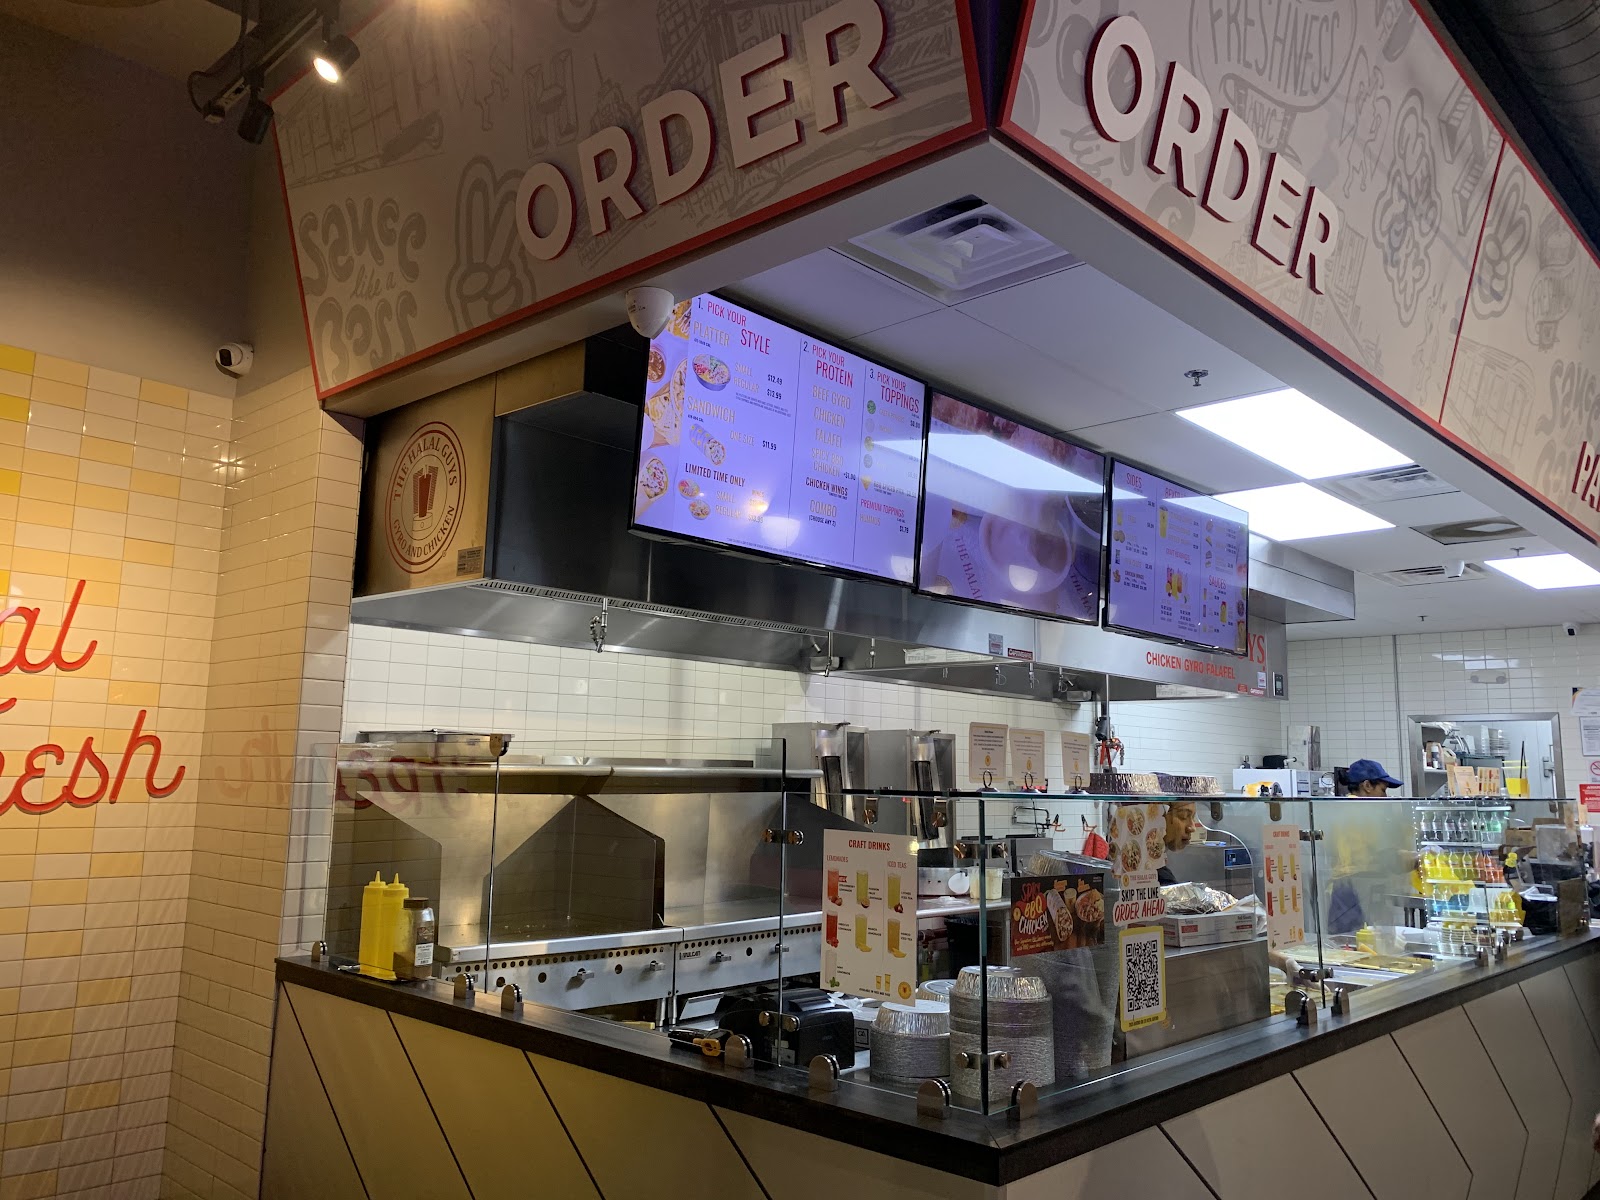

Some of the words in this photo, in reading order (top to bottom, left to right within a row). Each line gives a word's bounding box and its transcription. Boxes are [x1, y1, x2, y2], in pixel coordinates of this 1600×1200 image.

[1209, 0, 1340, 97] FRESHNESS
[515, 0, 899, 261] ORDER
[1084, 15, 1339, 295] ORDER
[707, 301, 725, 319] PICK
[727, 309, 747, 327] YOUR
[693, 321, 730, 347] PLATTER
[740, 329, 771, 355] STYLE
[803, 341, 810, 353] 2.
[812, 344, 827, 359] PICK
[828, 350, 845, 367] YOUR
[734, 361, 753, 377] SMALL
[816, 360, 854, 388] PROTEIN
[733, 377, 760, 393] REGULAR
[876, 371, 890, 386] PICK
[891, 377, 907, 392] YOUR
[812, 385, 830, 401] BEEF
[832, 391, 851, 410] GYRO
[881, 385, 920, 414] TOPPINGS
[687, 396, 736, 424] SANDWICH
[814, 406, 846, 428] CHICKEN
[730, 430, 742, 441] ONE
[743, 434, 755, 446] SIZE
[762, 440, 777, 451] $11.99
[815, 428, 842, 448] FALAFEL
[812, 447, 829, 461] SPICY
[394, 462, 410, 501] THE
[409, 436, 441, 463] HALAL
[441, 444, 458, 486] GUYS
[685, 462, 712, 479] LIMITED
[713, 470, 728, 483] TIME
[729, 475, 746, 487] ONLY
[813, 461, 840, 478] CHICKEN
[1126, 472, 1142, 489] SIDES
[1572, 441, 1600, 513] PA
[716, 491, 735, 504] SMALL
[805, 477, 829, 492] CHICKEN
[831, 482, 848, 496] WINGS
[809, 499, 837, 518] COMBO
[860, 498, 882, 512] PREMIUM
[882, 504, 905, 518] TOPPINGS
[393, 519, 407, 550] GYRO
[406, 544, 423, 558] AND
[423, 505, 455, 555] CHICKEN
[955, 537, 968, 561] THE
[1071, 574, 1085, 594] THE
[1208, 575, 1227, 590] SAUCES
[0, 579, 97, 676] al
[1146, 651, 1181, 669] CHICKEN
[1184, 658, 1204, 674] GYRO
[1206, 662, 1236, 679] FALAFEL
[848, 839, 867, 850] CRAFT
[867, 840, 891, 851] DRINKS
[826, 854, 849, 864] LEMONADES
[887, 861, 896, 869] ICED
[1121, 889, 1134, 902] SKIP
[1136, 887, 1147, 900] THE
[1147, 886, 1159, 899] LINE
[1024, 895, 1043, 919] BBQ
[1114, 902, 1139, 922] ORDER
[1141, 898, 1165, 917] AHEAD
[1018, 911, 1048, 935] CHICKEN
